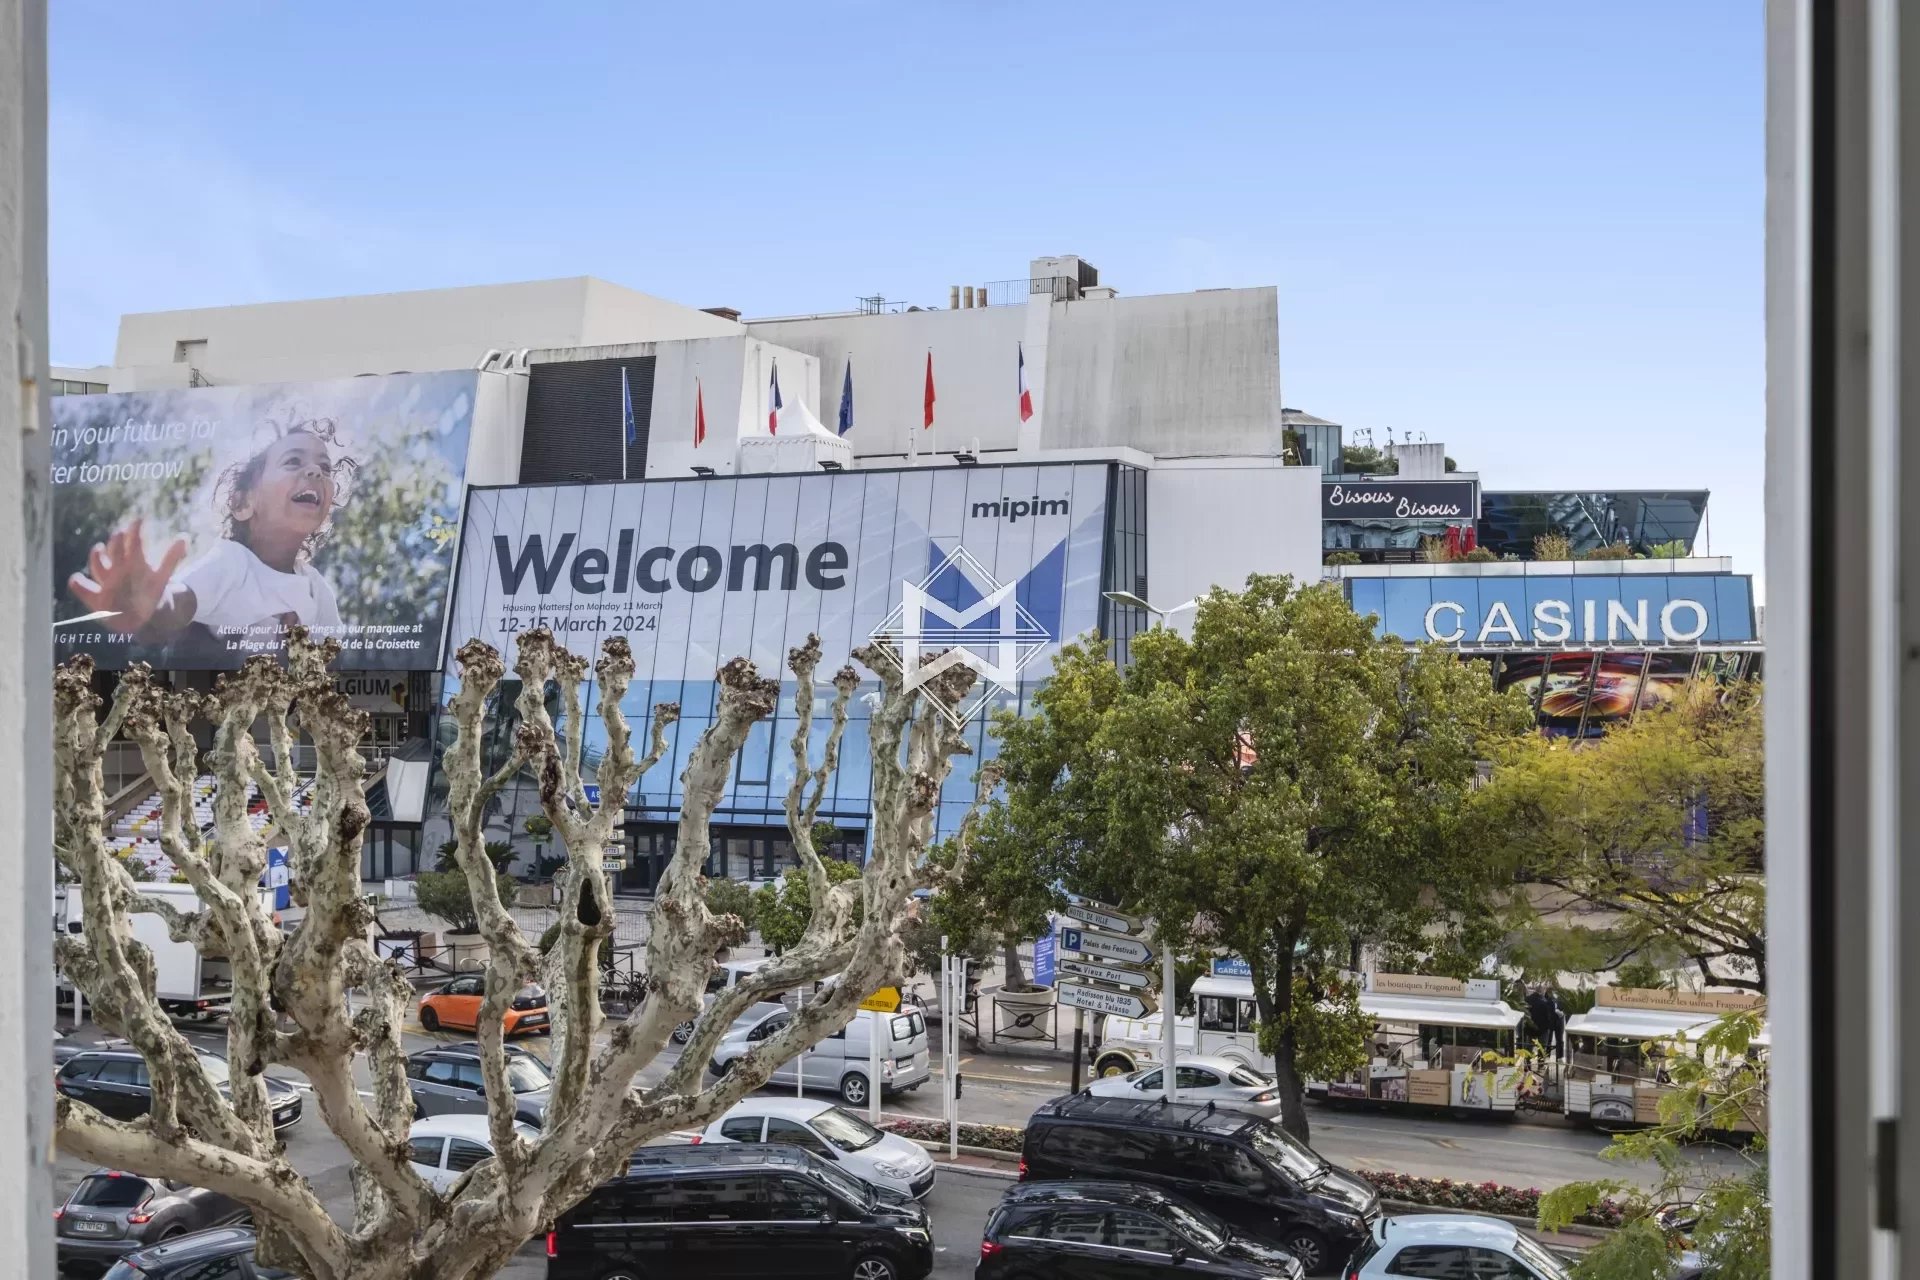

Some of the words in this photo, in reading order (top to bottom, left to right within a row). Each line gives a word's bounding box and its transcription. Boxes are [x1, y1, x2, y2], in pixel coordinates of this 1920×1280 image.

[70, 425, 120, 452] your
[122, 418, 186, 443] future
[190, 419, 221, 441] for
[80, 460, 184, 482] tomorrow
[1330, 485, 1394, 506] Bisous
[971, 496, 1069, 523] mipim
[1396, 497, 1461, 518] Bisous
[493, 528, 849, 596] Welcome
[502, 602, 536, 614] Housing
[587, 602, 620, 612] Monday
[623, 602, 633, 610] 11
[636, 602, 663, 611] March
[499, 617, 549, 633] 12-15
[553, 616, 606, 632] March
[612, 616, 656, 632] 2024
[1423, 599, 1709, 643] CASINO
[108, 633, 134, 644] WAY
[217, 624, 248, 635] Attend
[249, 625, 273, 637] your
[335, 624, 347, 634] at
[348, 624, 366, 634] our
[367, 624, 410, 636] marquee
[411, 624, 423, 633] at
[226, 640, 238, 650] La
[239, 640, 265, 652] Plage
[267, 640, 279, 650] du
[350, 639, 363, 649] de
[364, 639, 374, 649] la
[375, 639, 420, 650] Croisette
[336, 679, 390, 696] LGIUM
[1069, 933, 1077, 946] P
[1083, 939, 1099, 949] Palais
[1101, 942, 1111, 951] des
[1113, 944, 1138, 955] Festivals
[1083, 967, 1103, 977] Vieux
[1106, 971, 1121, 981] Port
[1217, 967, 1238, 975] GARE
[1376, 979, 1386, 987] les
[1387, 980, 1422, 990] boutiques
[1425, 982, 1461, 993] Fragonard
[1076, 989, 1104, 1000] Radisson
[1105, 994, 1115, 1003] blu
[1677, 997, 1687, 1005] les
[1689, 998, 1714, 1008] usines
[1716, 1000, 1757, 1011] Fragonard
[1076, 997, 1094, 1007] Hotel
[1105, 1003, 1130, 1014] Talasso
